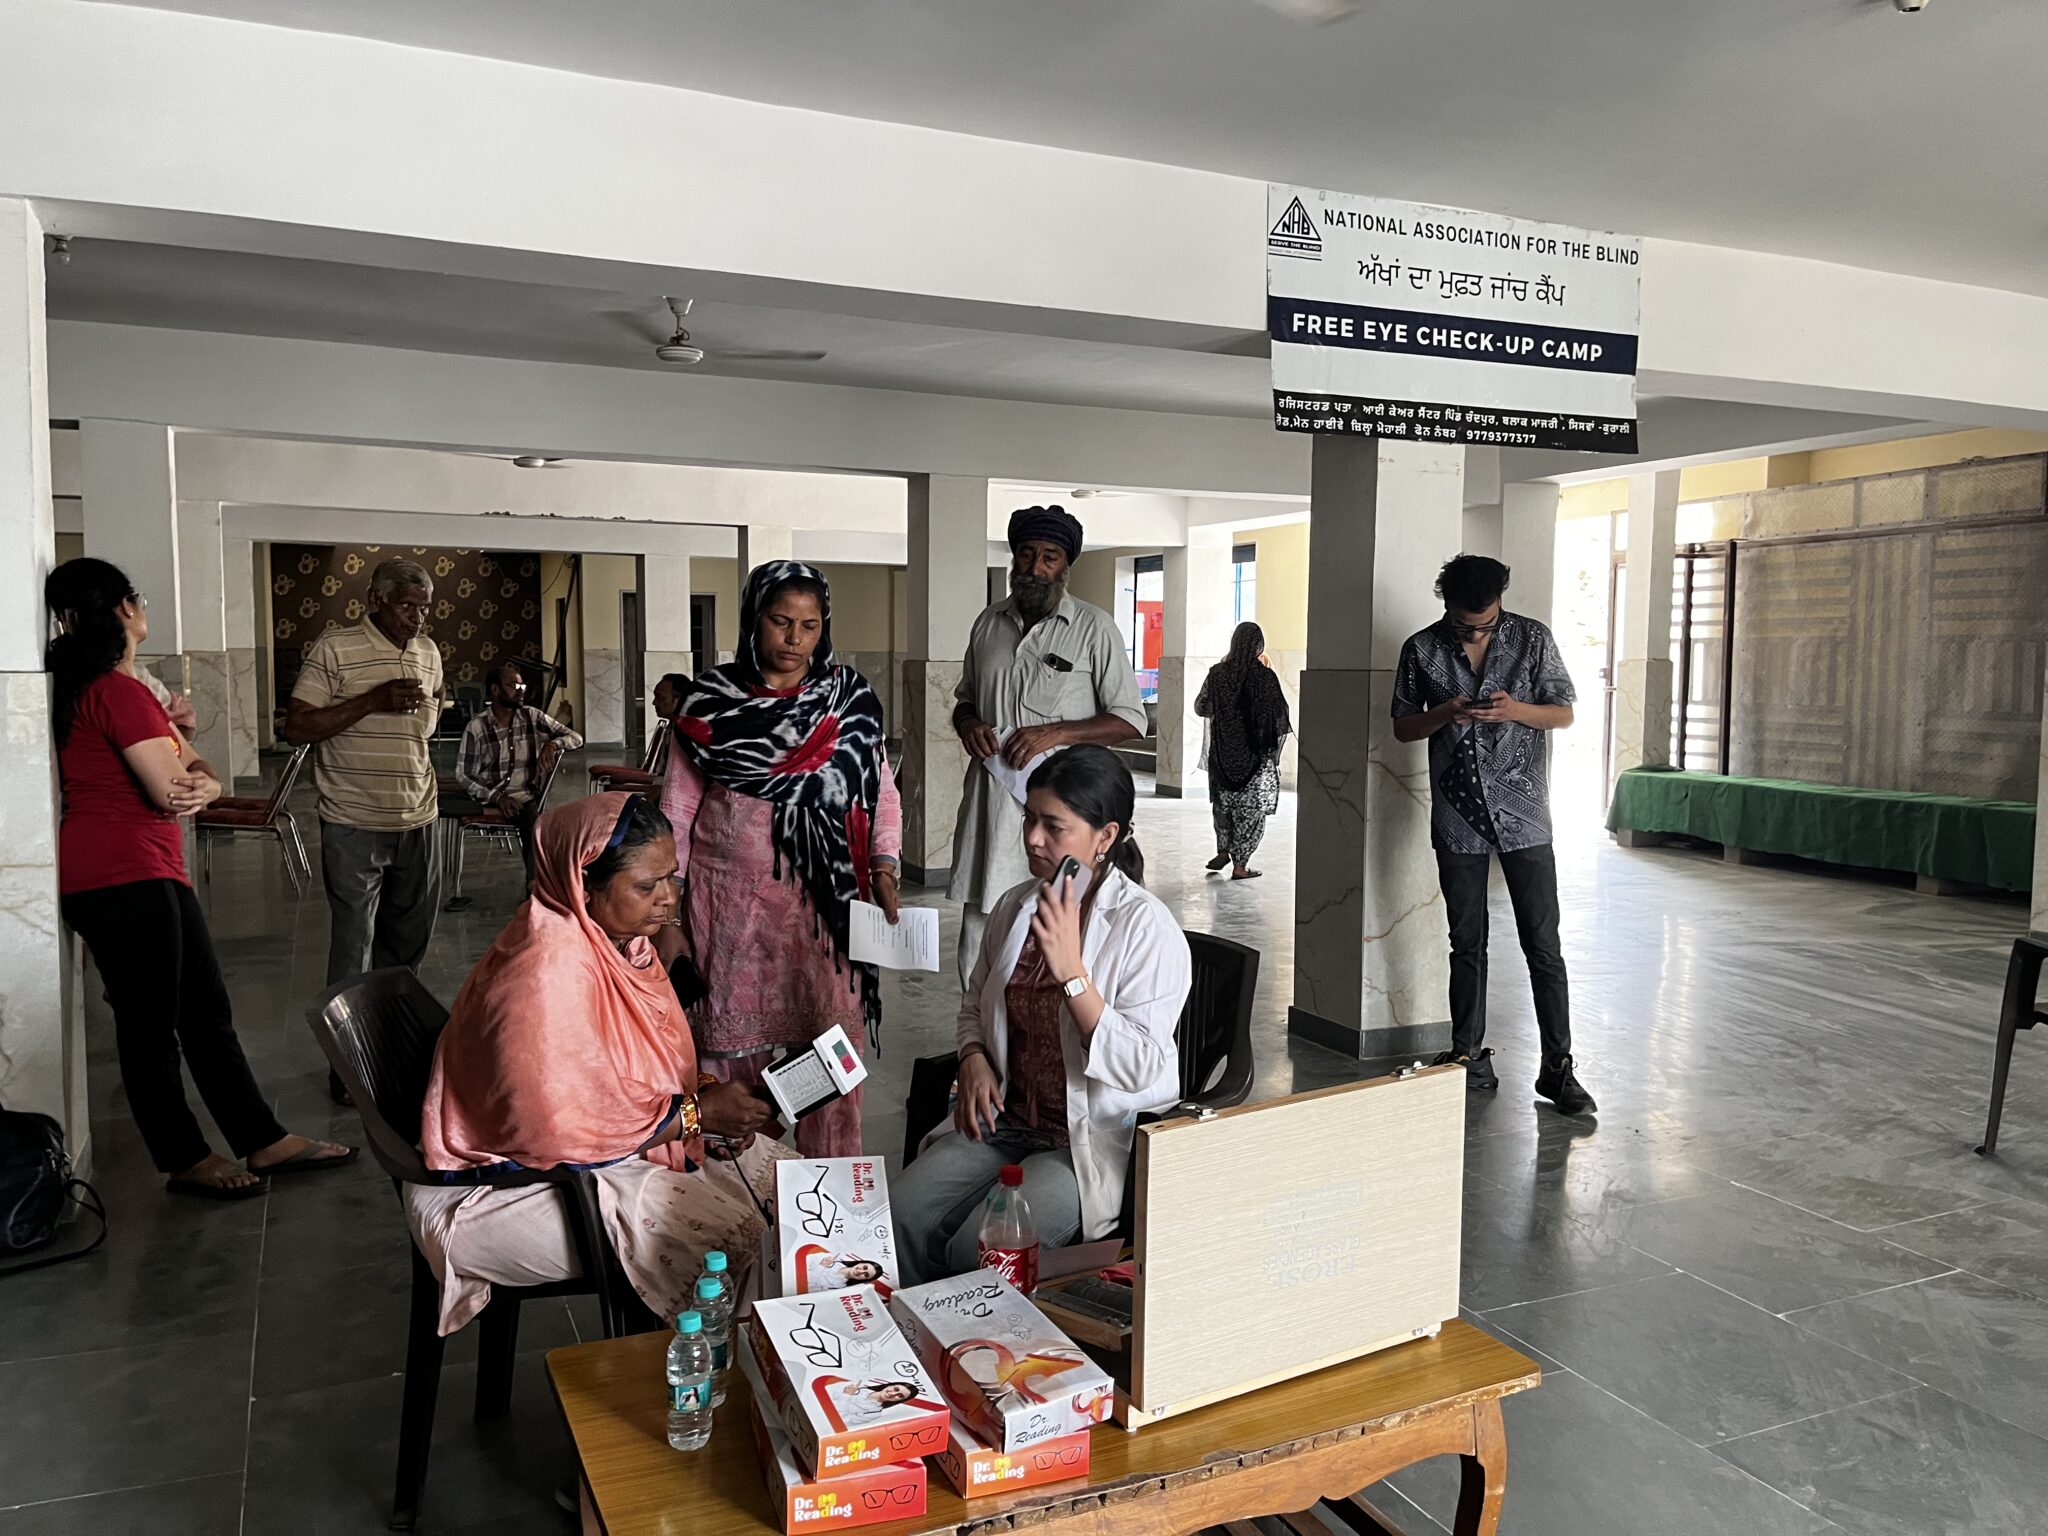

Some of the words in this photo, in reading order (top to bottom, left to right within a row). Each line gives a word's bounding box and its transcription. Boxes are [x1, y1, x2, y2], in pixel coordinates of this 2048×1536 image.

[1282, 203, 1310, 235] NAB
[1324, 209, 1407, 235] NATIONAL
[1413, 221, 1521, 250] ASSOCIATION
[1527, 236, 1557, 255] FOR
[1562, 241, 1591, 259] THE
[1597, 245, 1639, 265] BLIND
[1357, 253, 1401, 286] ਅੱਖਾਂ
[1408, 266, 1432, 289] ਦਾ
[1439, 270, 1483, 298] ਮੁਫ਼ਤ
[1490, 272, 1529, 301] ਜਾਂਚ
[1535, 274, 1566, 306] ਕੈਂਪ
[1292, 312, 1354, 338] FREE
[1363, 320, 1408, 343] EYE
[1416, 326, 1535, 355] CHECK-UP
[1541, 339, 1603, 362] CAMP
[1278, 396, 1330, 411] ਰਜਿਸਟਰਡ
[1334, 402, 1352, 412] ਪਤਾ
[1362, 403, 1385, 416] ਆਈ
[1388, 404, 1414, 418] ਕੇਅਰ
[1445, 408, 1462, 421] ਪਿੰਡ
[1502, 416, 1528, 427] ਬਲਾਕ
[1466, 430, 1536, 444] 9779377377
[863, 1163, 873, 1175] Dr.
[852, 1162, 865, 1203] Reading
[850, 1293, 863, 1306] Dr.
[923, 1281, 1004, 1311] Reading
[840, 1295, 868, 1332] Reading
[956, 1302, 993, 1318] Dr.
[1030, 1414, 1049, 1429] Dr.
[1013, 1423, 1062, 1446] Reading
[825, 1447, 880, 1468] Reading
[826, 1446, 844, 1457] Dr.
[973, 1461, 991, 1473] Dr.
[973, 1465, 1025, 1485] Reading
[794, 1497, 814, 1510] Dr.
[794, 1503, 853, 1522] Reading
